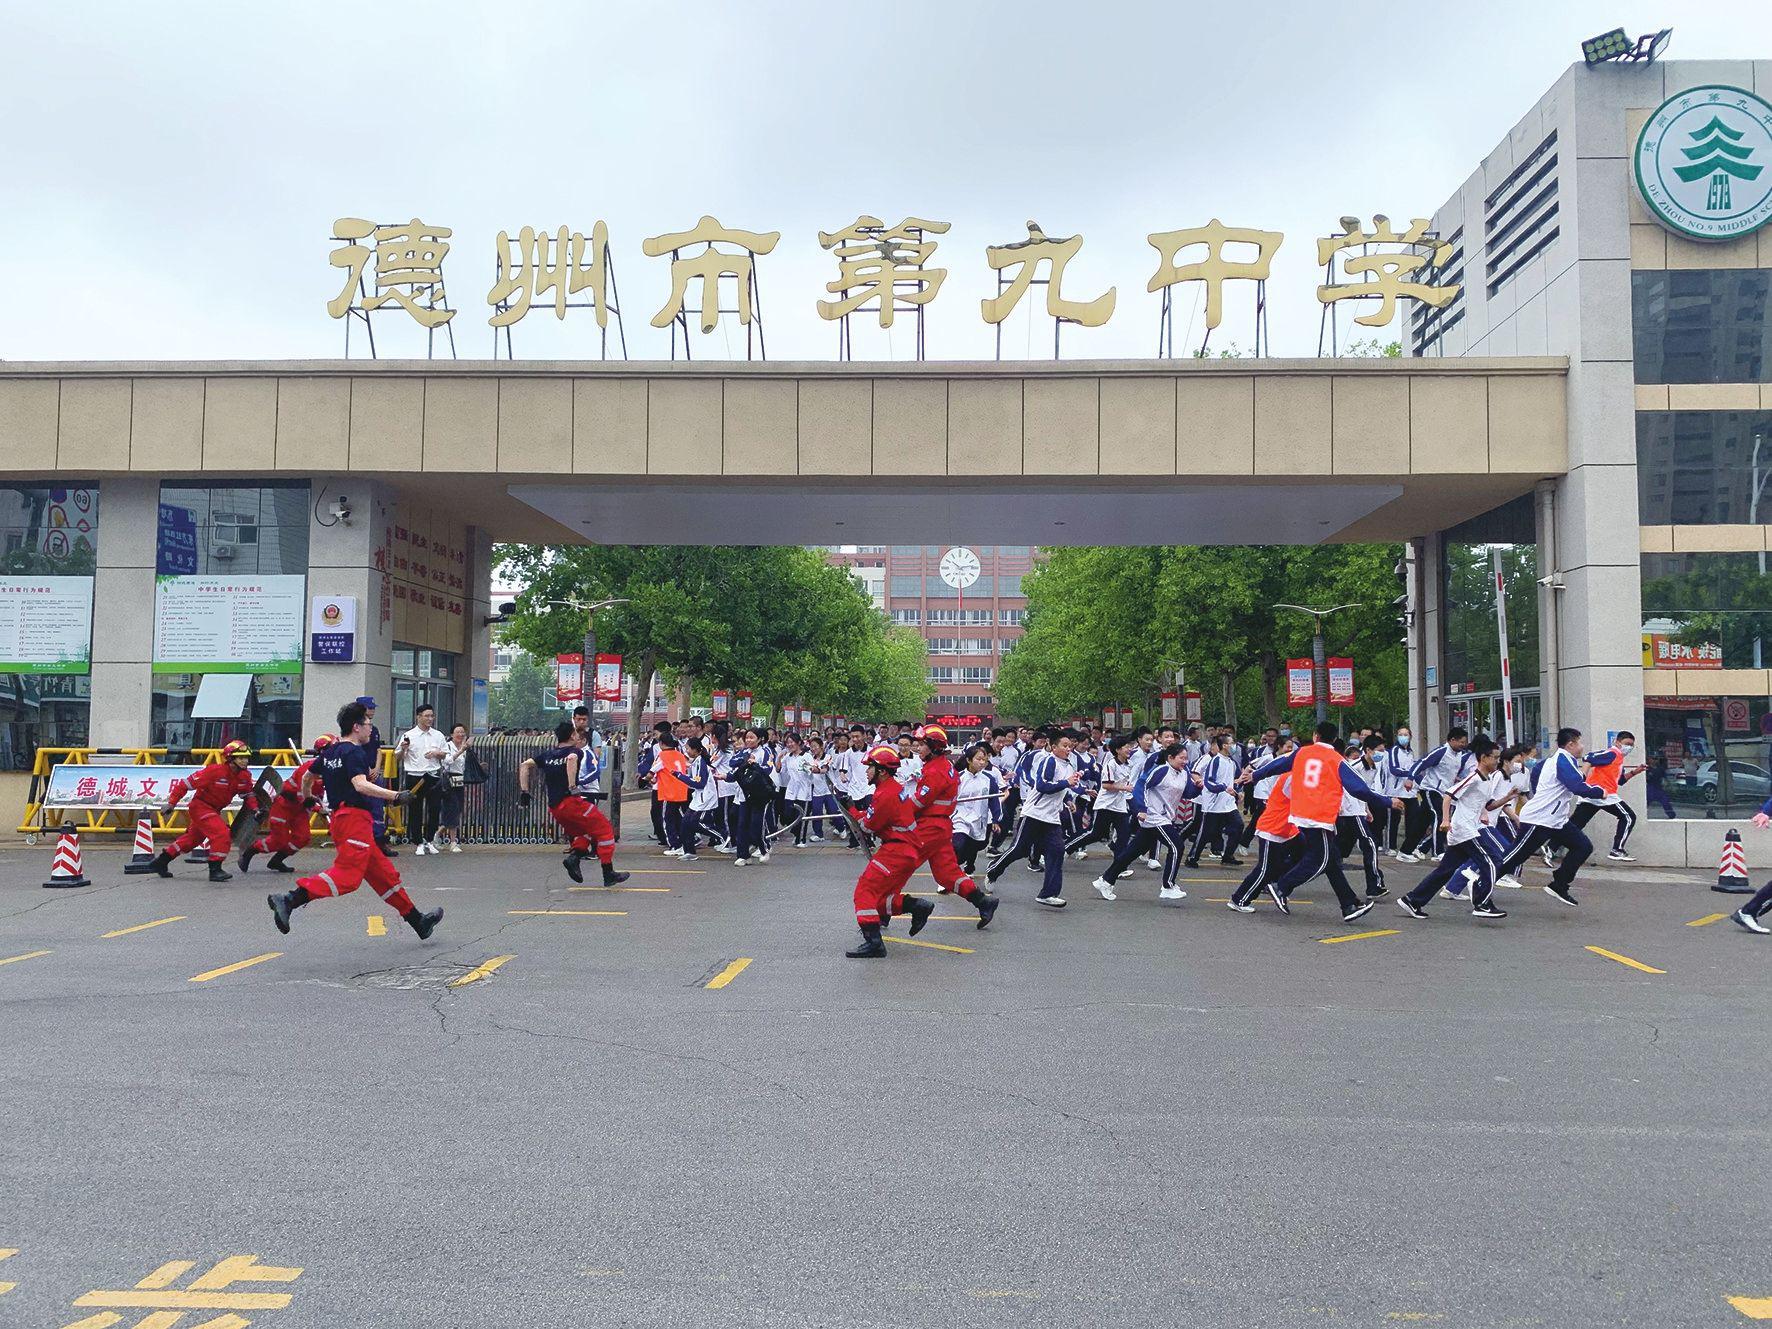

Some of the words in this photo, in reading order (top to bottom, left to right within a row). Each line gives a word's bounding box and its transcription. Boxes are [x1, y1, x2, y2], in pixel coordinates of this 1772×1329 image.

[1648, 184, 1659, 198] DE
[1659, 199, 1685, 223] ZHOU
[1689, 221, 1713, 231] NO.9
[1717, 214, 1759, 231] MIDDLE
[1761, 199, 1772, 214] SC
[327, 215, 1461, 335] 德州市第九中学
[1304, 758, 1323, 788] 8
